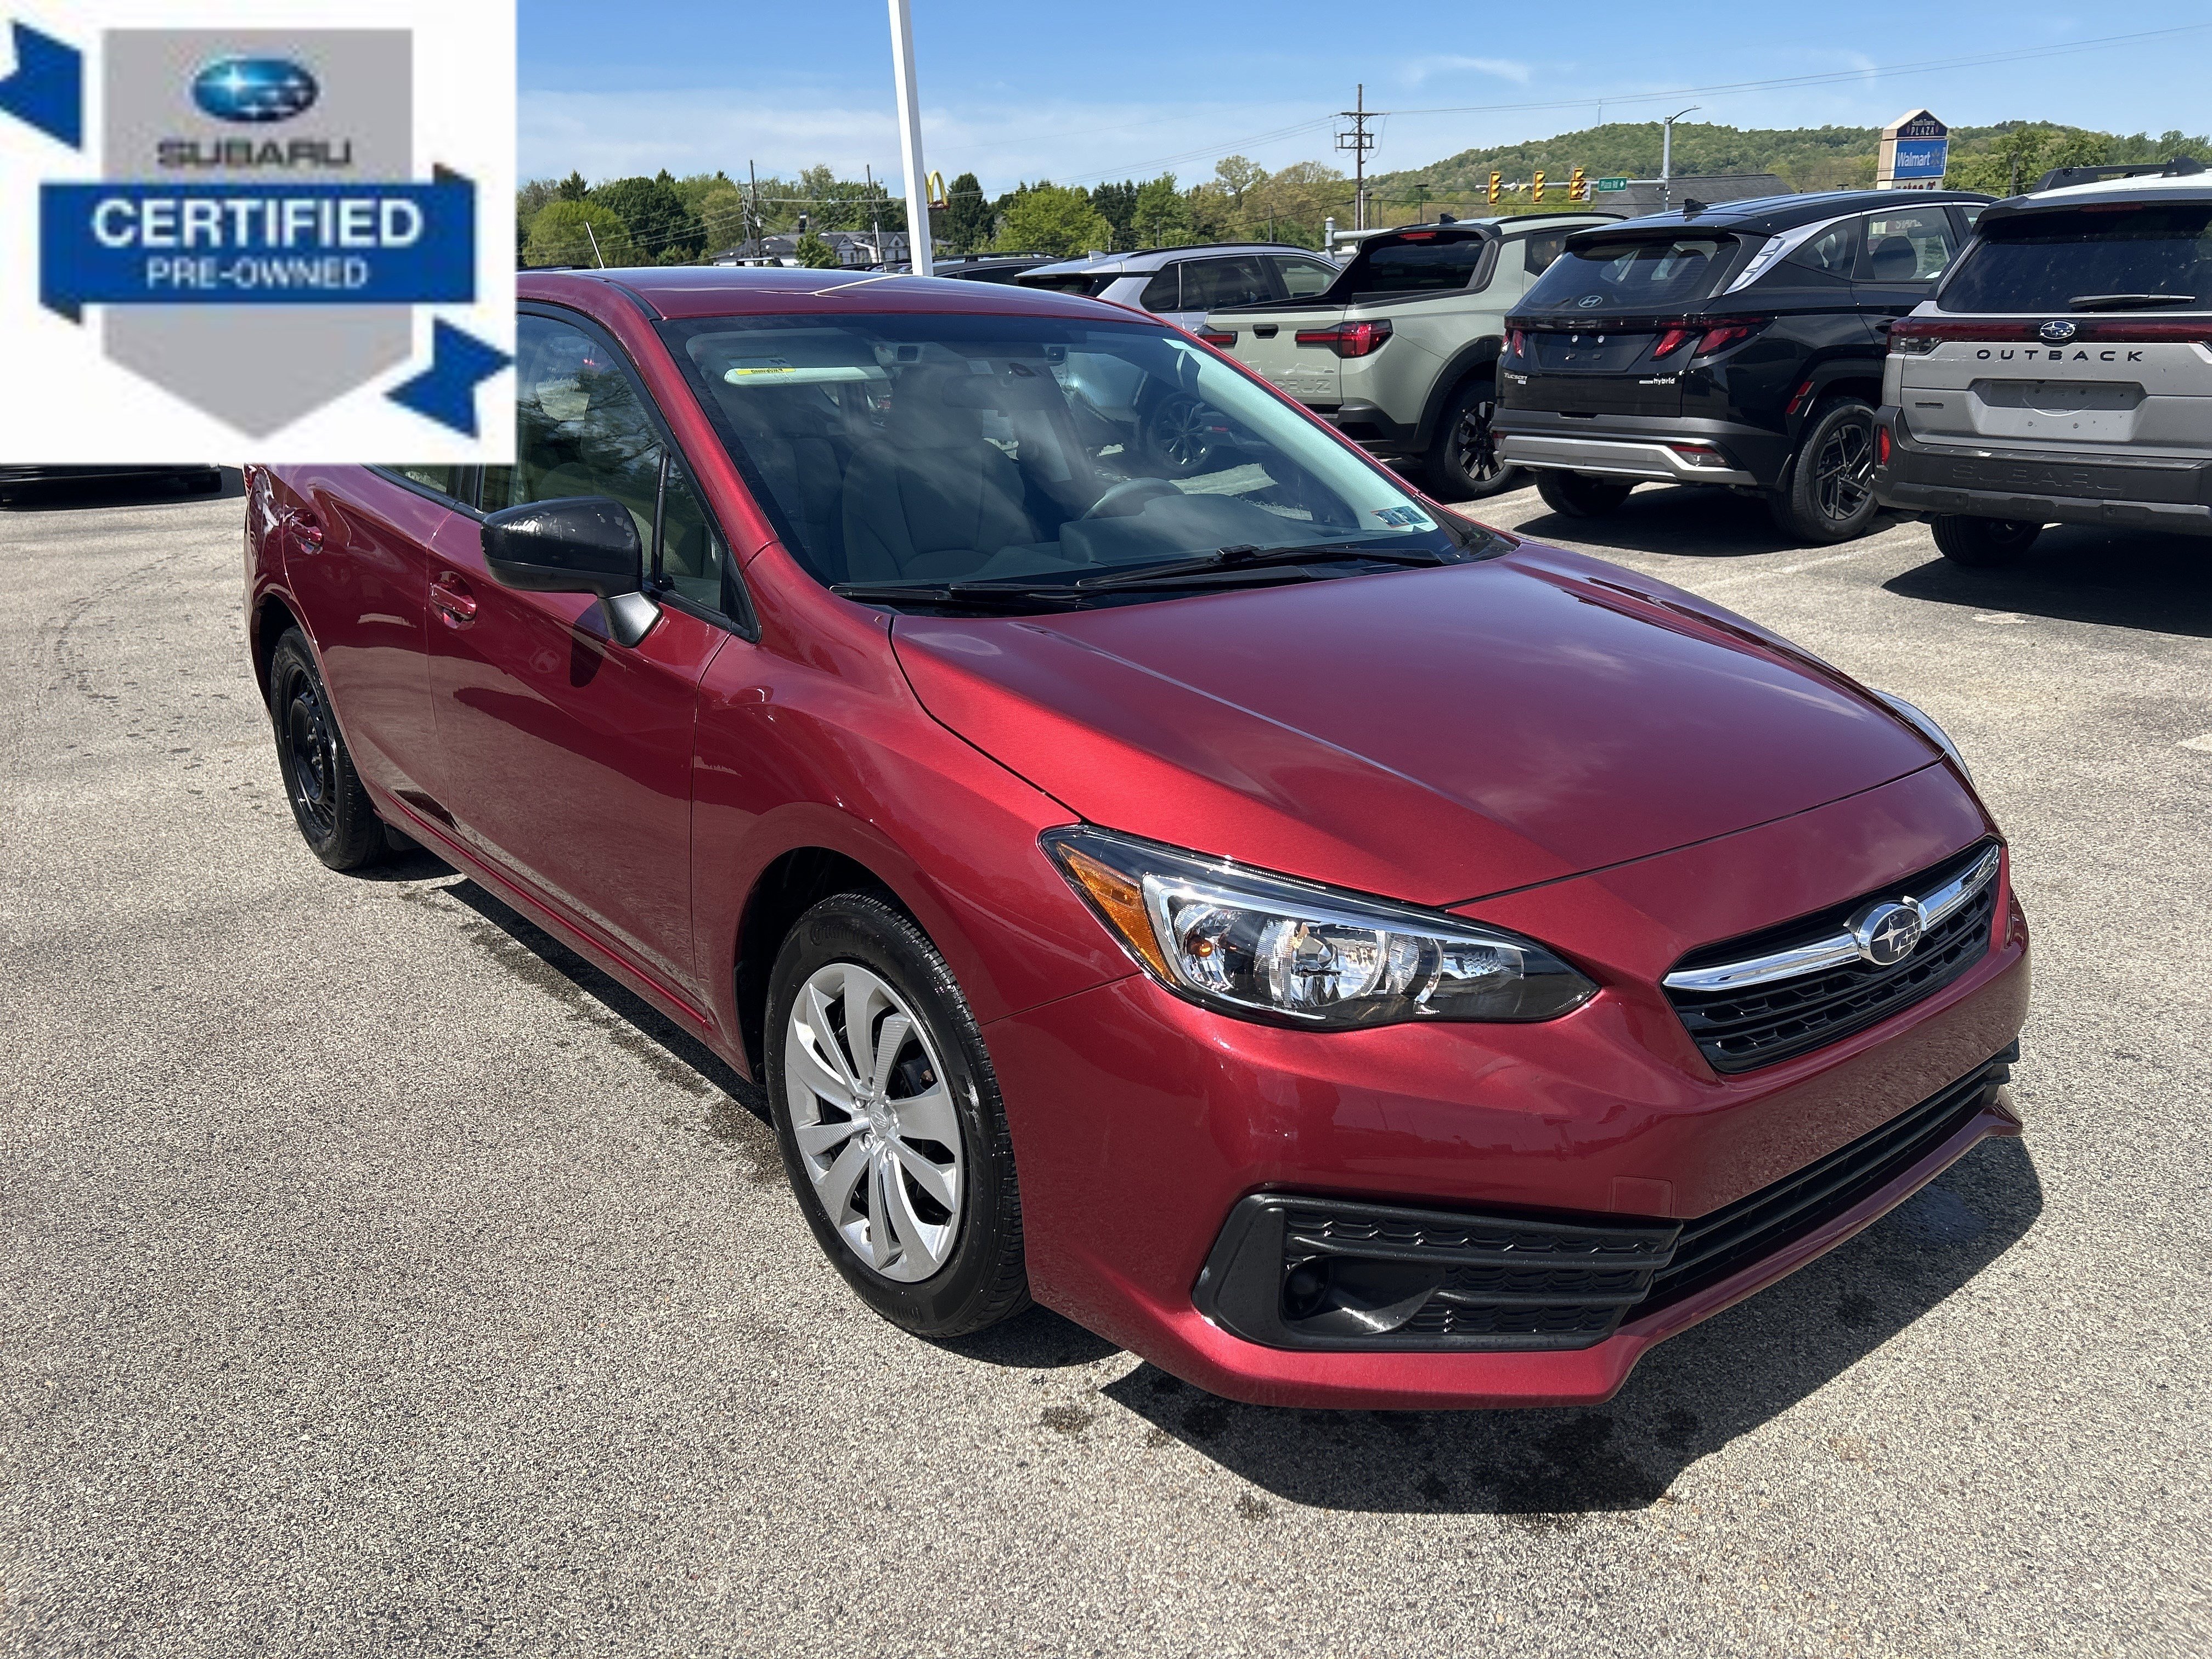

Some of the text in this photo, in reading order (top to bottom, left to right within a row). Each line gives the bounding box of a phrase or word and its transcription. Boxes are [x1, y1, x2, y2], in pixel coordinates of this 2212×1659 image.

[1911, 126, 1934, 136] PLAZA
[1898, 151, 1931, 167] Walmart
[1977, 349, 2143, 362] OUTBACK
[1654, 377, 1675, 386] hybrid
[1953, 464, 2124, 493] SUBARU
